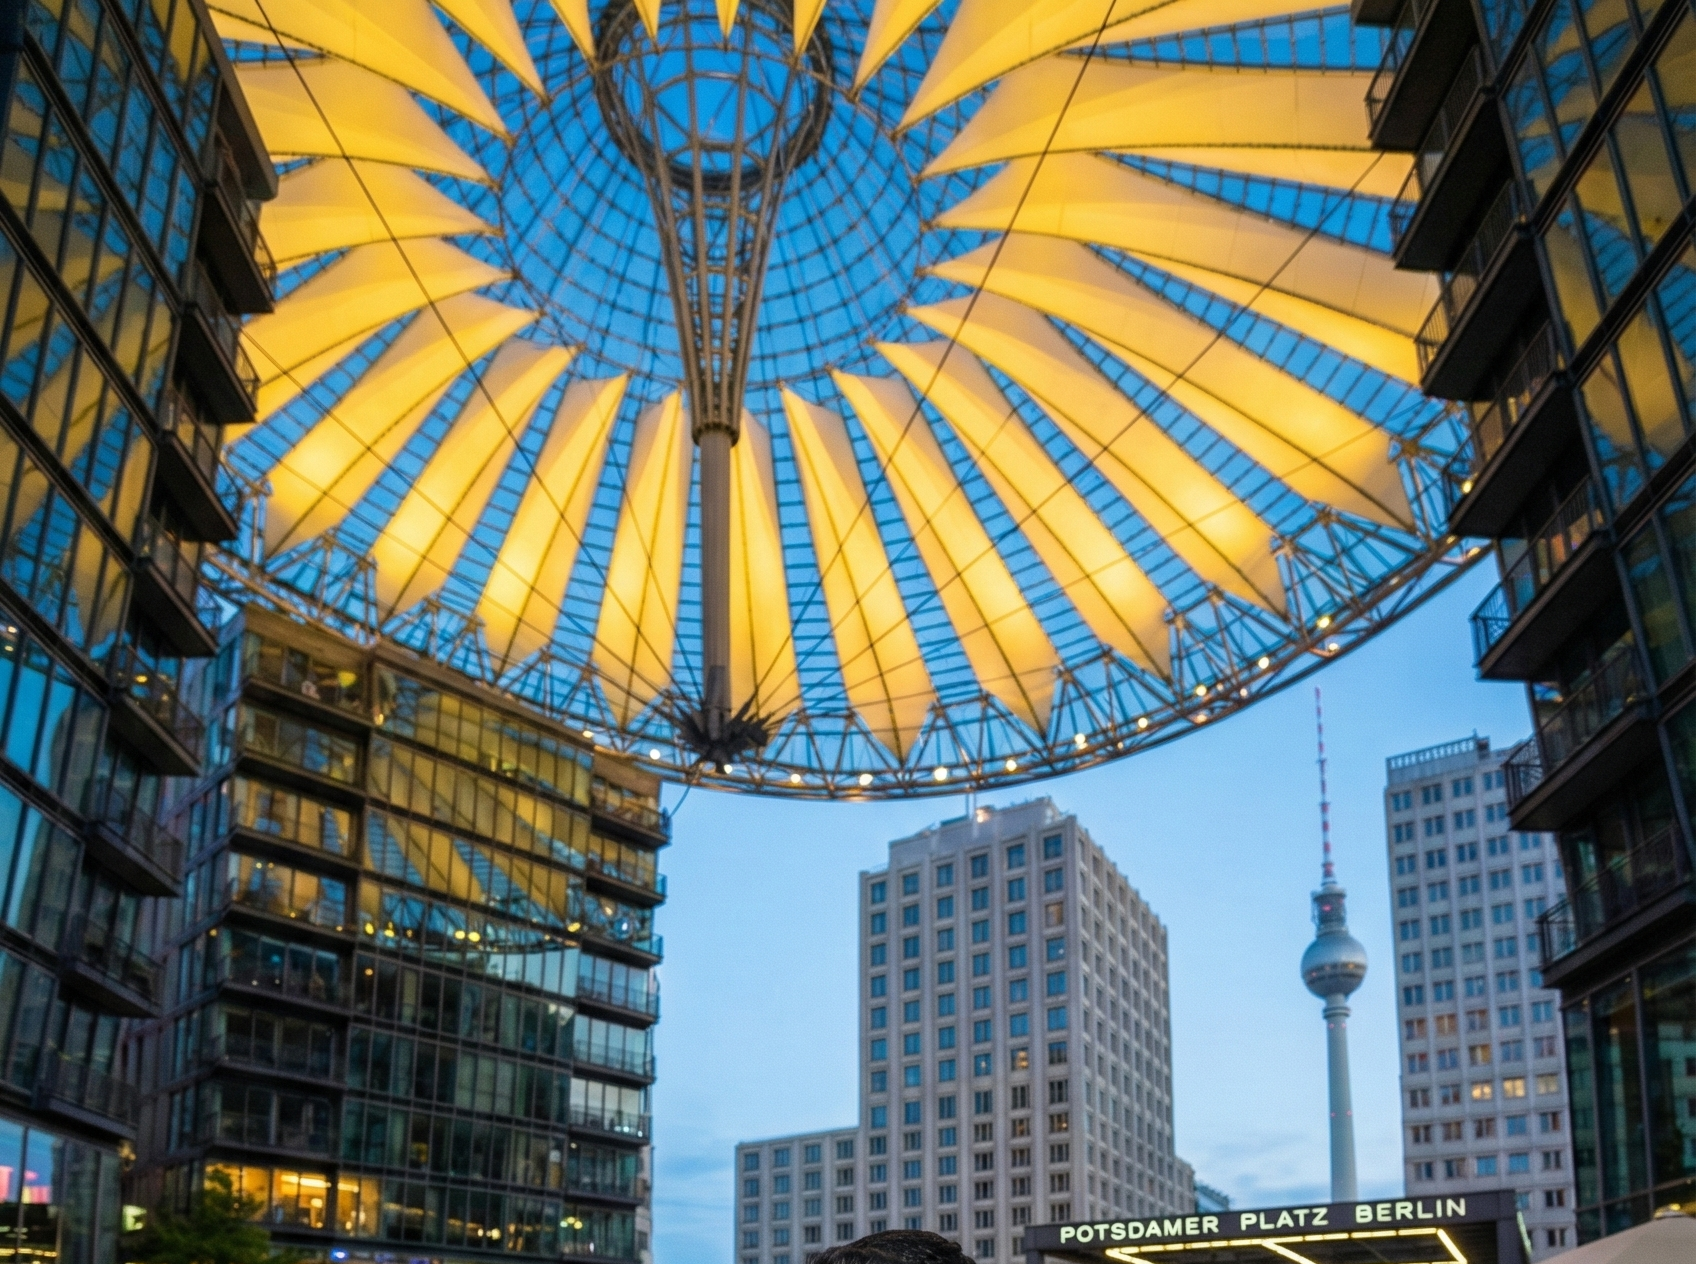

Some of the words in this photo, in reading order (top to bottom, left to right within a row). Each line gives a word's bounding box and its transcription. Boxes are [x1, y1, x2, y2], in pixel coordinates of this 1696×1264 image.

[1060, 1216, 1219, 1244] POTSDAMER
[1240, 1207, 1329, 1231] PLATZ
[1355, 1198, 1467, 1224] BERLIN
